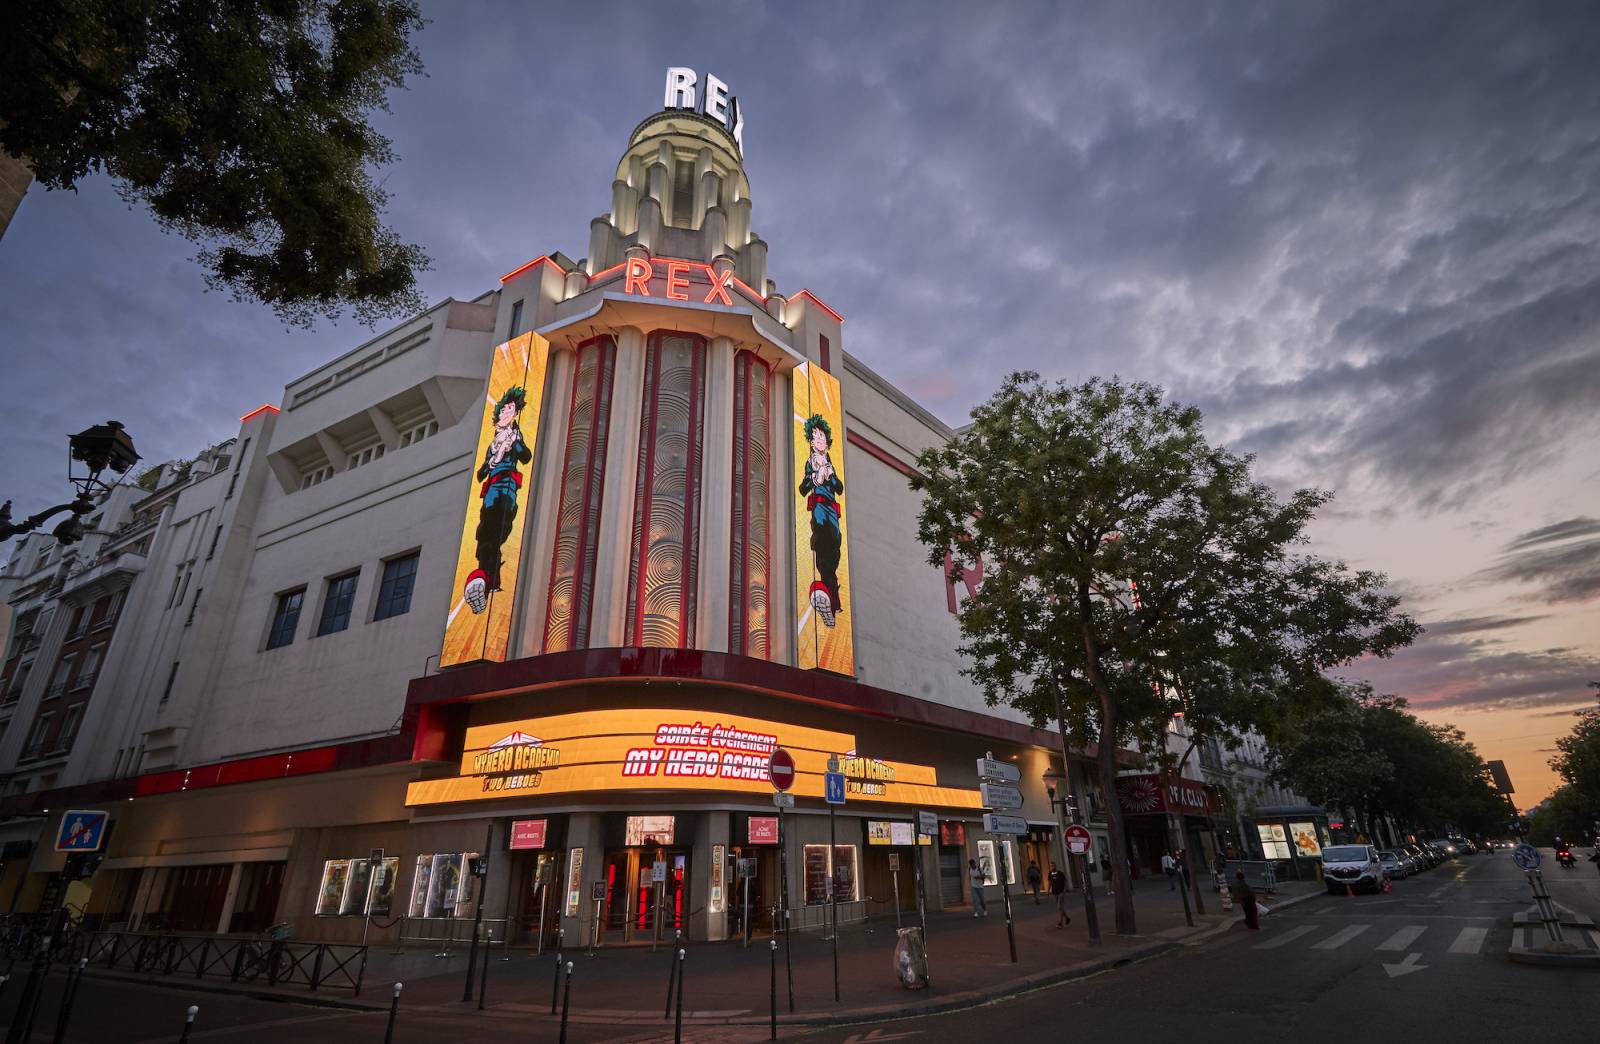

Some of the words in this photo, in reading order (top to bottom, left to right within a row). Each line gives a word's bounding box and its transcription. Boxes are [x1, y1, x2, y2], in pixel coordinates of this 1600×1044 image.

[664, 66, 744, 161] REX
[625, 256, 733, 306] REX
[656, 722, 710, 745] SOIRÉE
[487, 745, 513, 773] HERO
[515, 744, 560, 770] ACADEMIA
[623, 748, 664, 776] MY
[665, 749, 720, 778] HERO
[721, 752, 771, 780] ACADE
